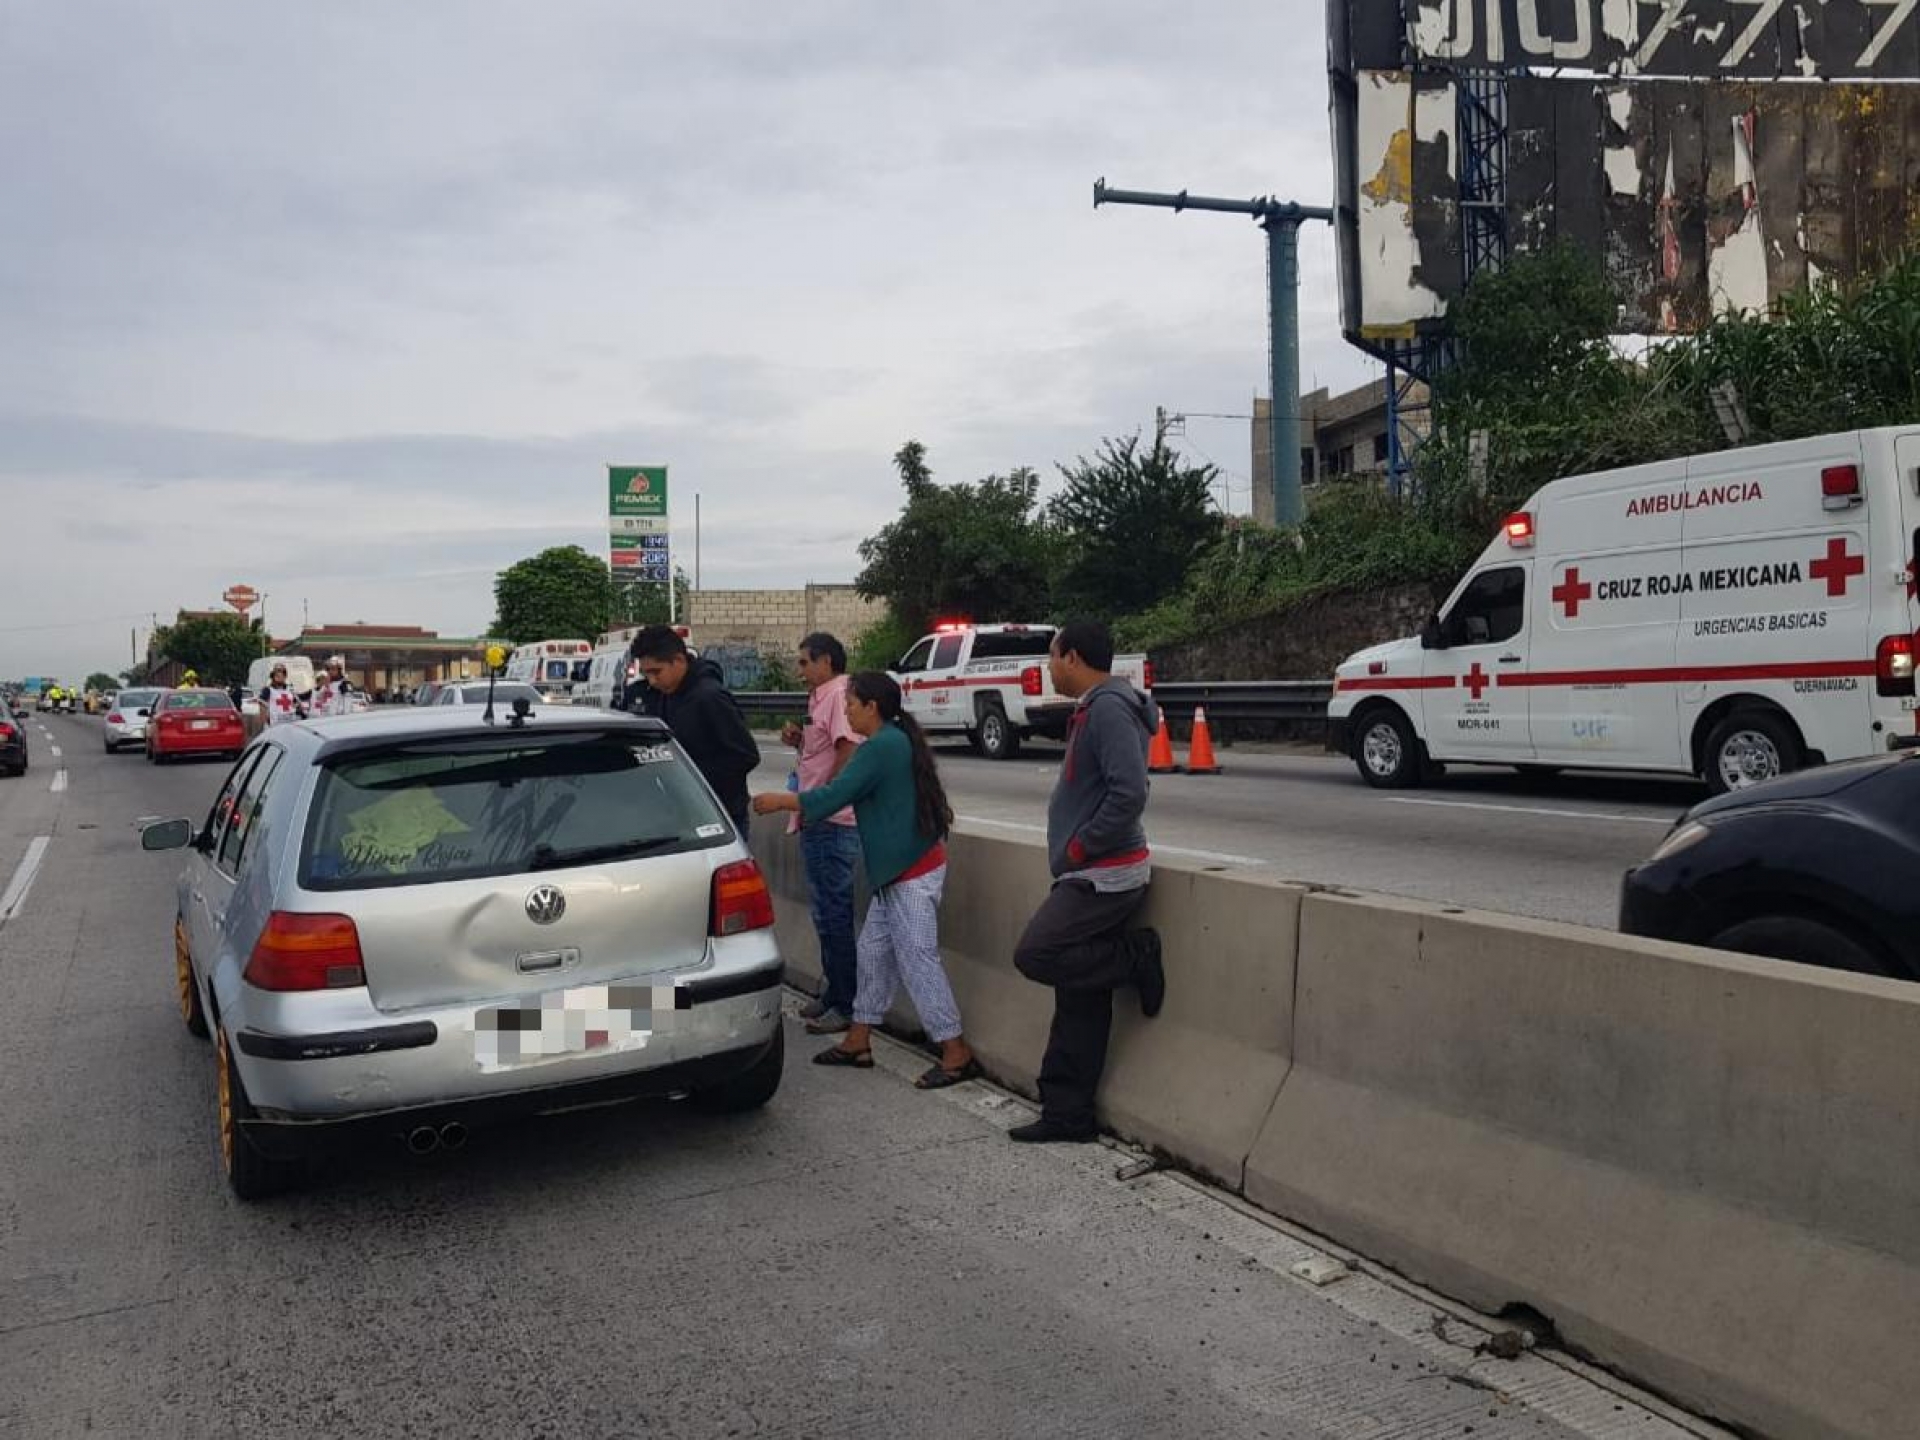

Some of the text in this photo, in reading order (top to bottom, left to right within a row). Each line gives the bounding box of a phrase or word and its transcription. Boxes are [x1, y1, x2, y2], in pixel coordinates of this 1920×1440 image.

[1626, 481, 1762, 517] AMBULANCIA
[1598, 561, 1801, 600] CRUZ ROJA MEXICANA
[1694, 611, 1827, 636] URGENCIAS BASICAS
[1794, 678, 1858, 693] CUERNAVACA
